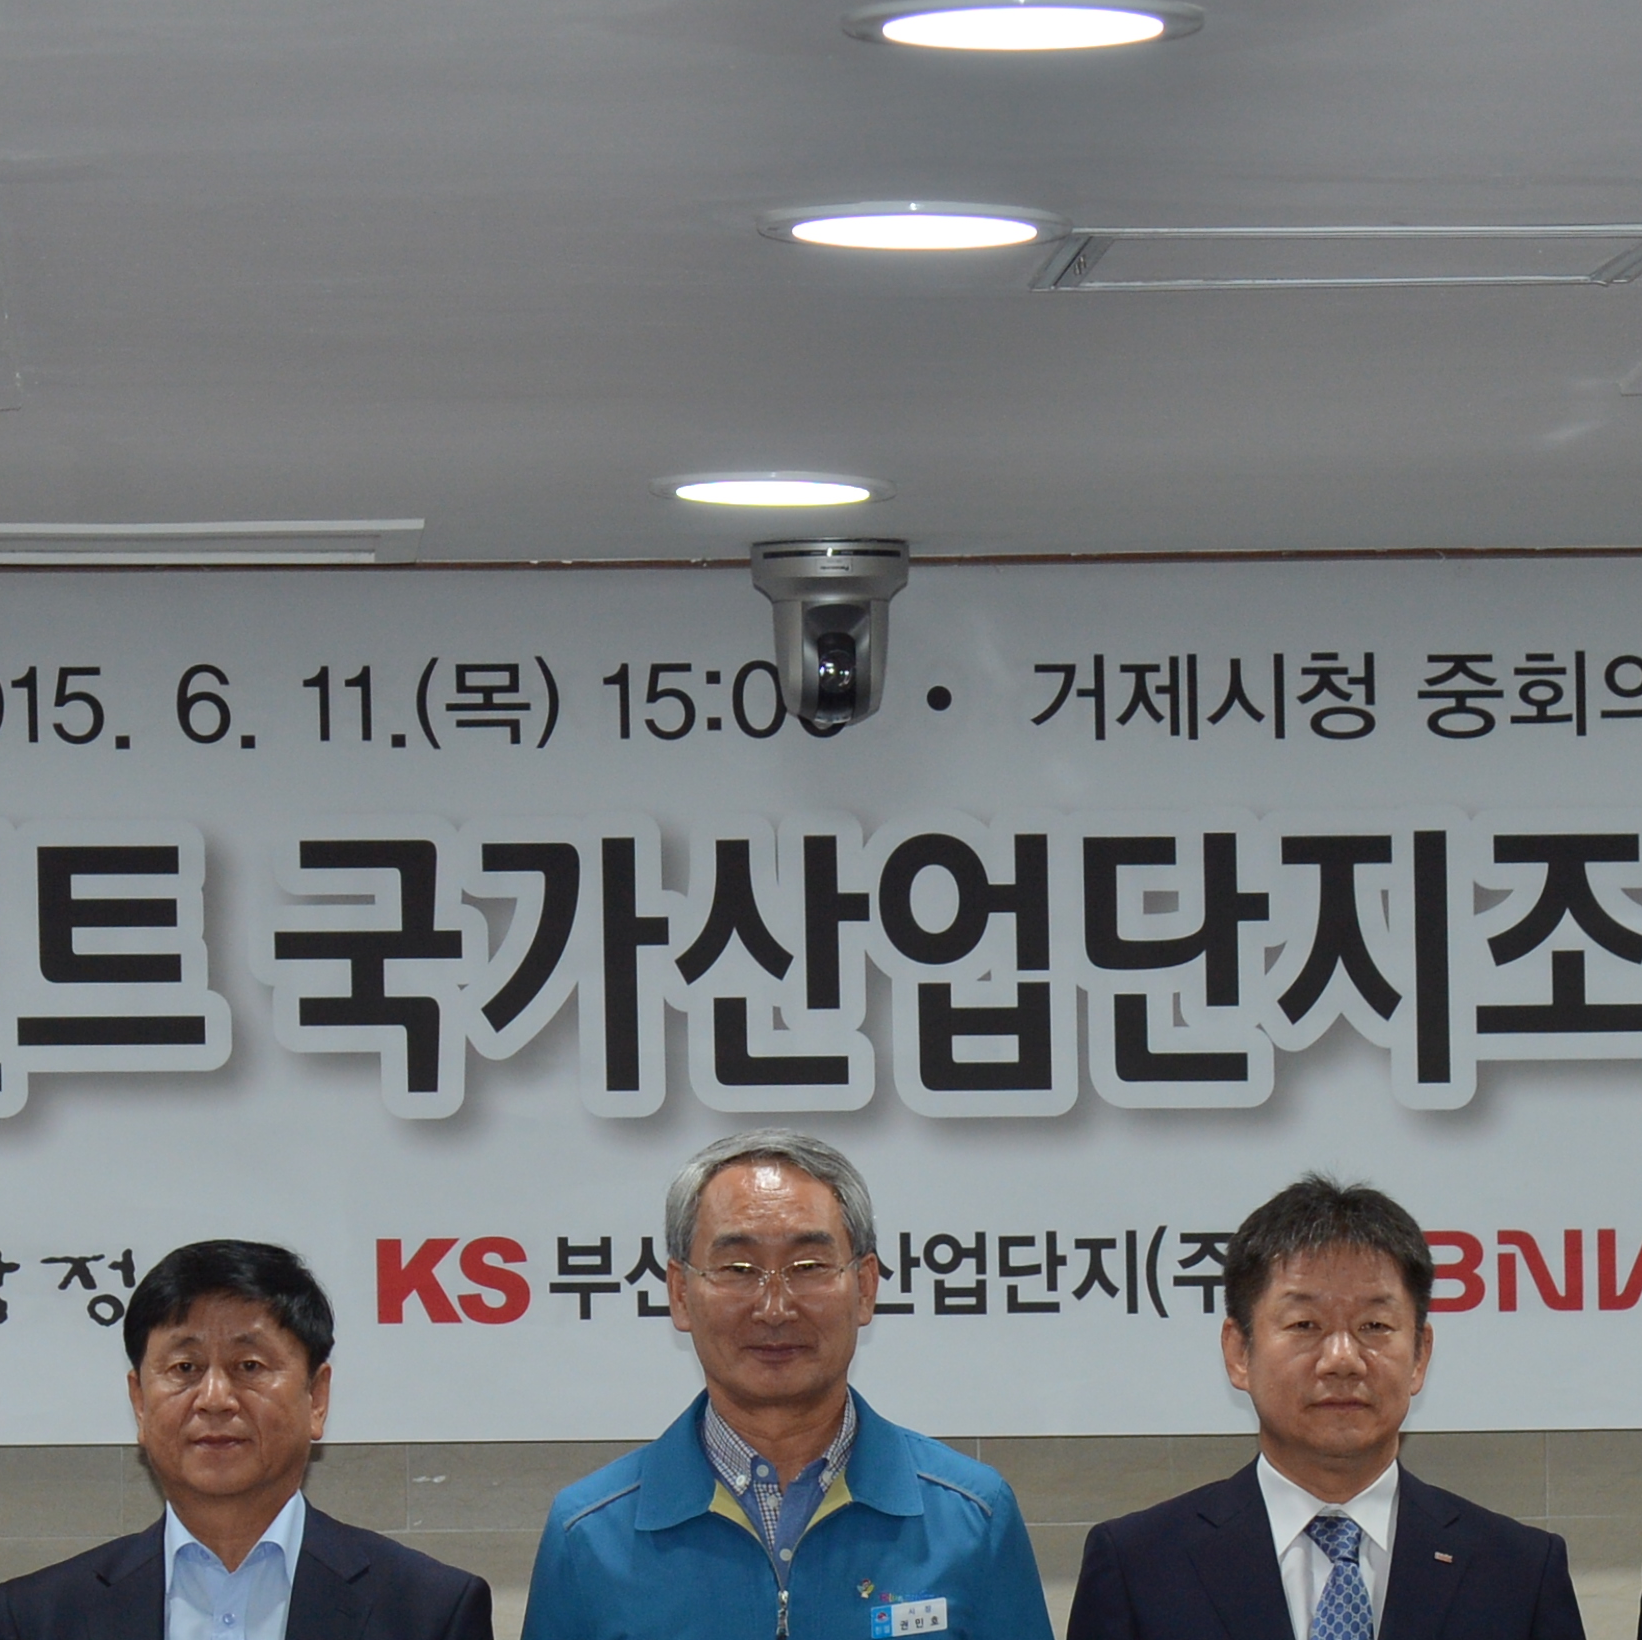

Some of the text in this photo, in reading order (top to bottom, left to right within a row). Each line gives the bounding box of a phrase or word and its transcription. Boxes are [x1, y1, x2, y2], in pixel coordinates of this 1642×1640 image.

[176, 663, 256, 750] 6.
[302, 655, 560, 750] 11.(목)
[604, 661, 846, 741] 15:0
[1030, 651, 1376, 741] 거제시청
[375, 1236, 531, 1325] KS
